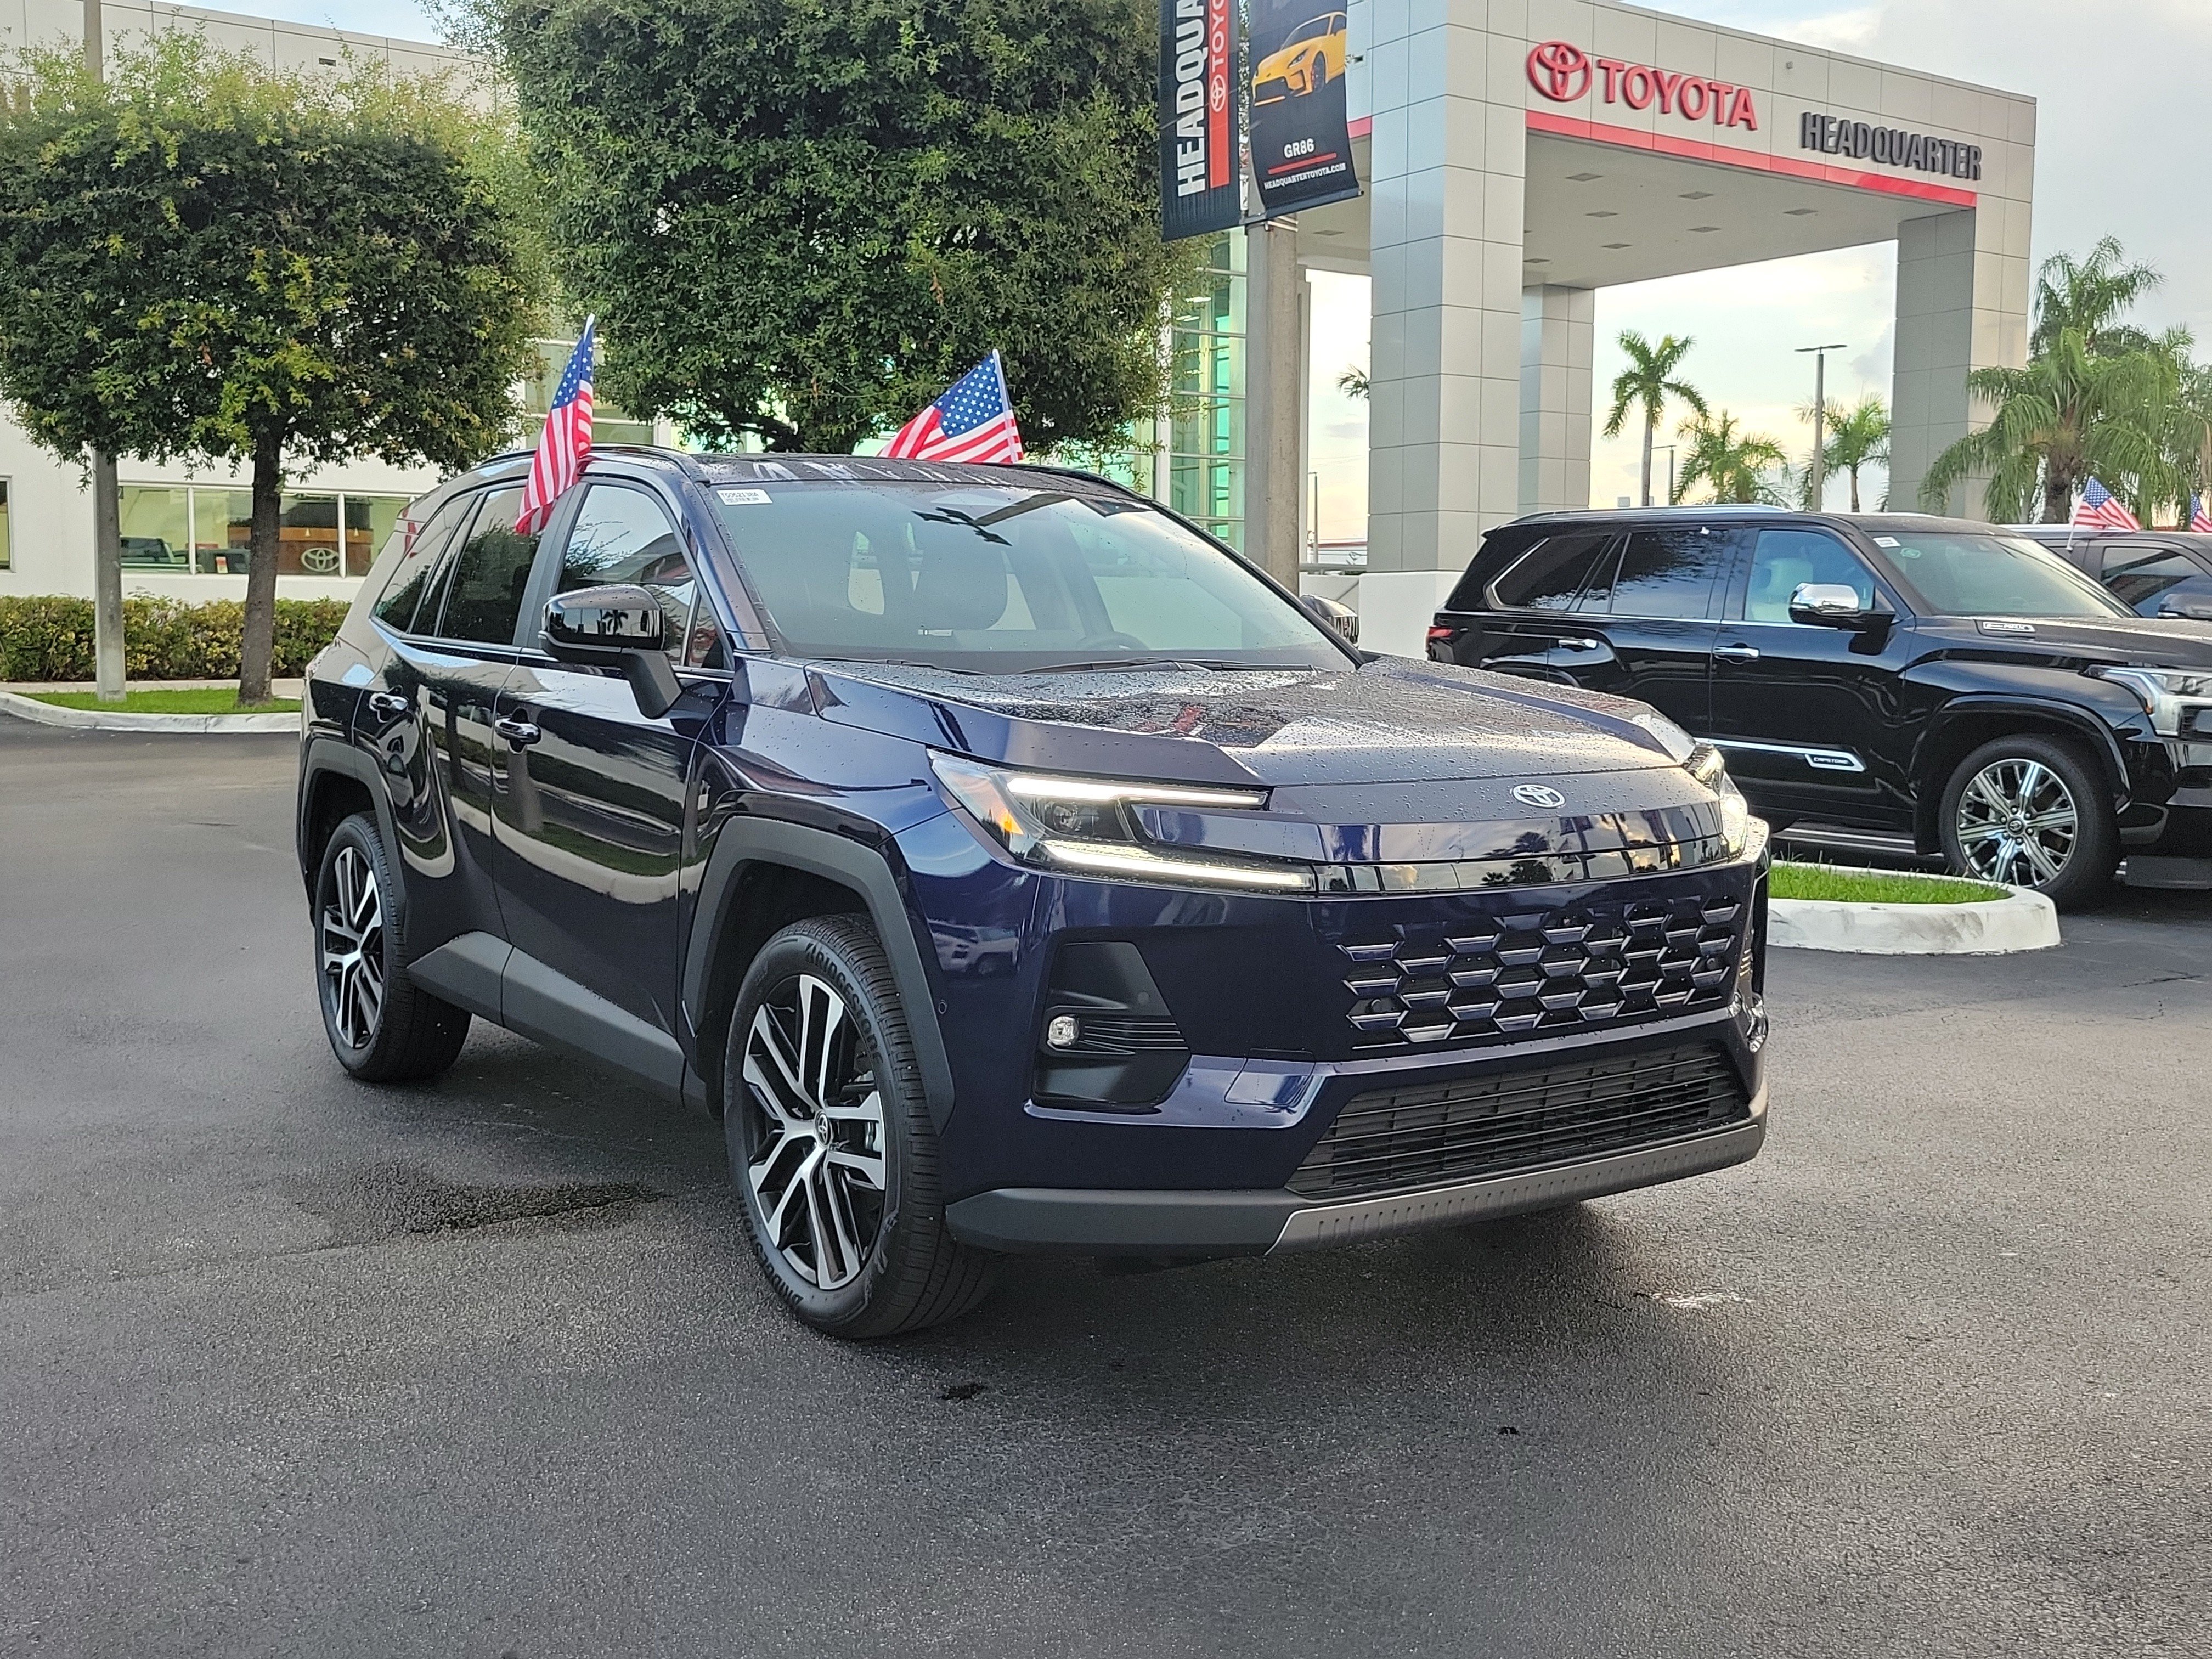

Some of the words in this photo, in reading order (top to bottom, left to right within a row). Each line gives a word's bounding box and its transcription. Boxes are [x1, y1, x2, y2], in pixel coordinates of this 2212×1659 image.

[1176, 0, 1209, 197] HEADQUA
[1596, 59, 1758, 131] TOYOTA
[1263, 162, 1346, 190] HEADQUARTERTOYOTA.COM
[1284, 138, 1315, 159] GR86
[1802, 112, 1982, 180] HEADQUARTER
[805, 942, 883, 1063] BRIDGESTONE
